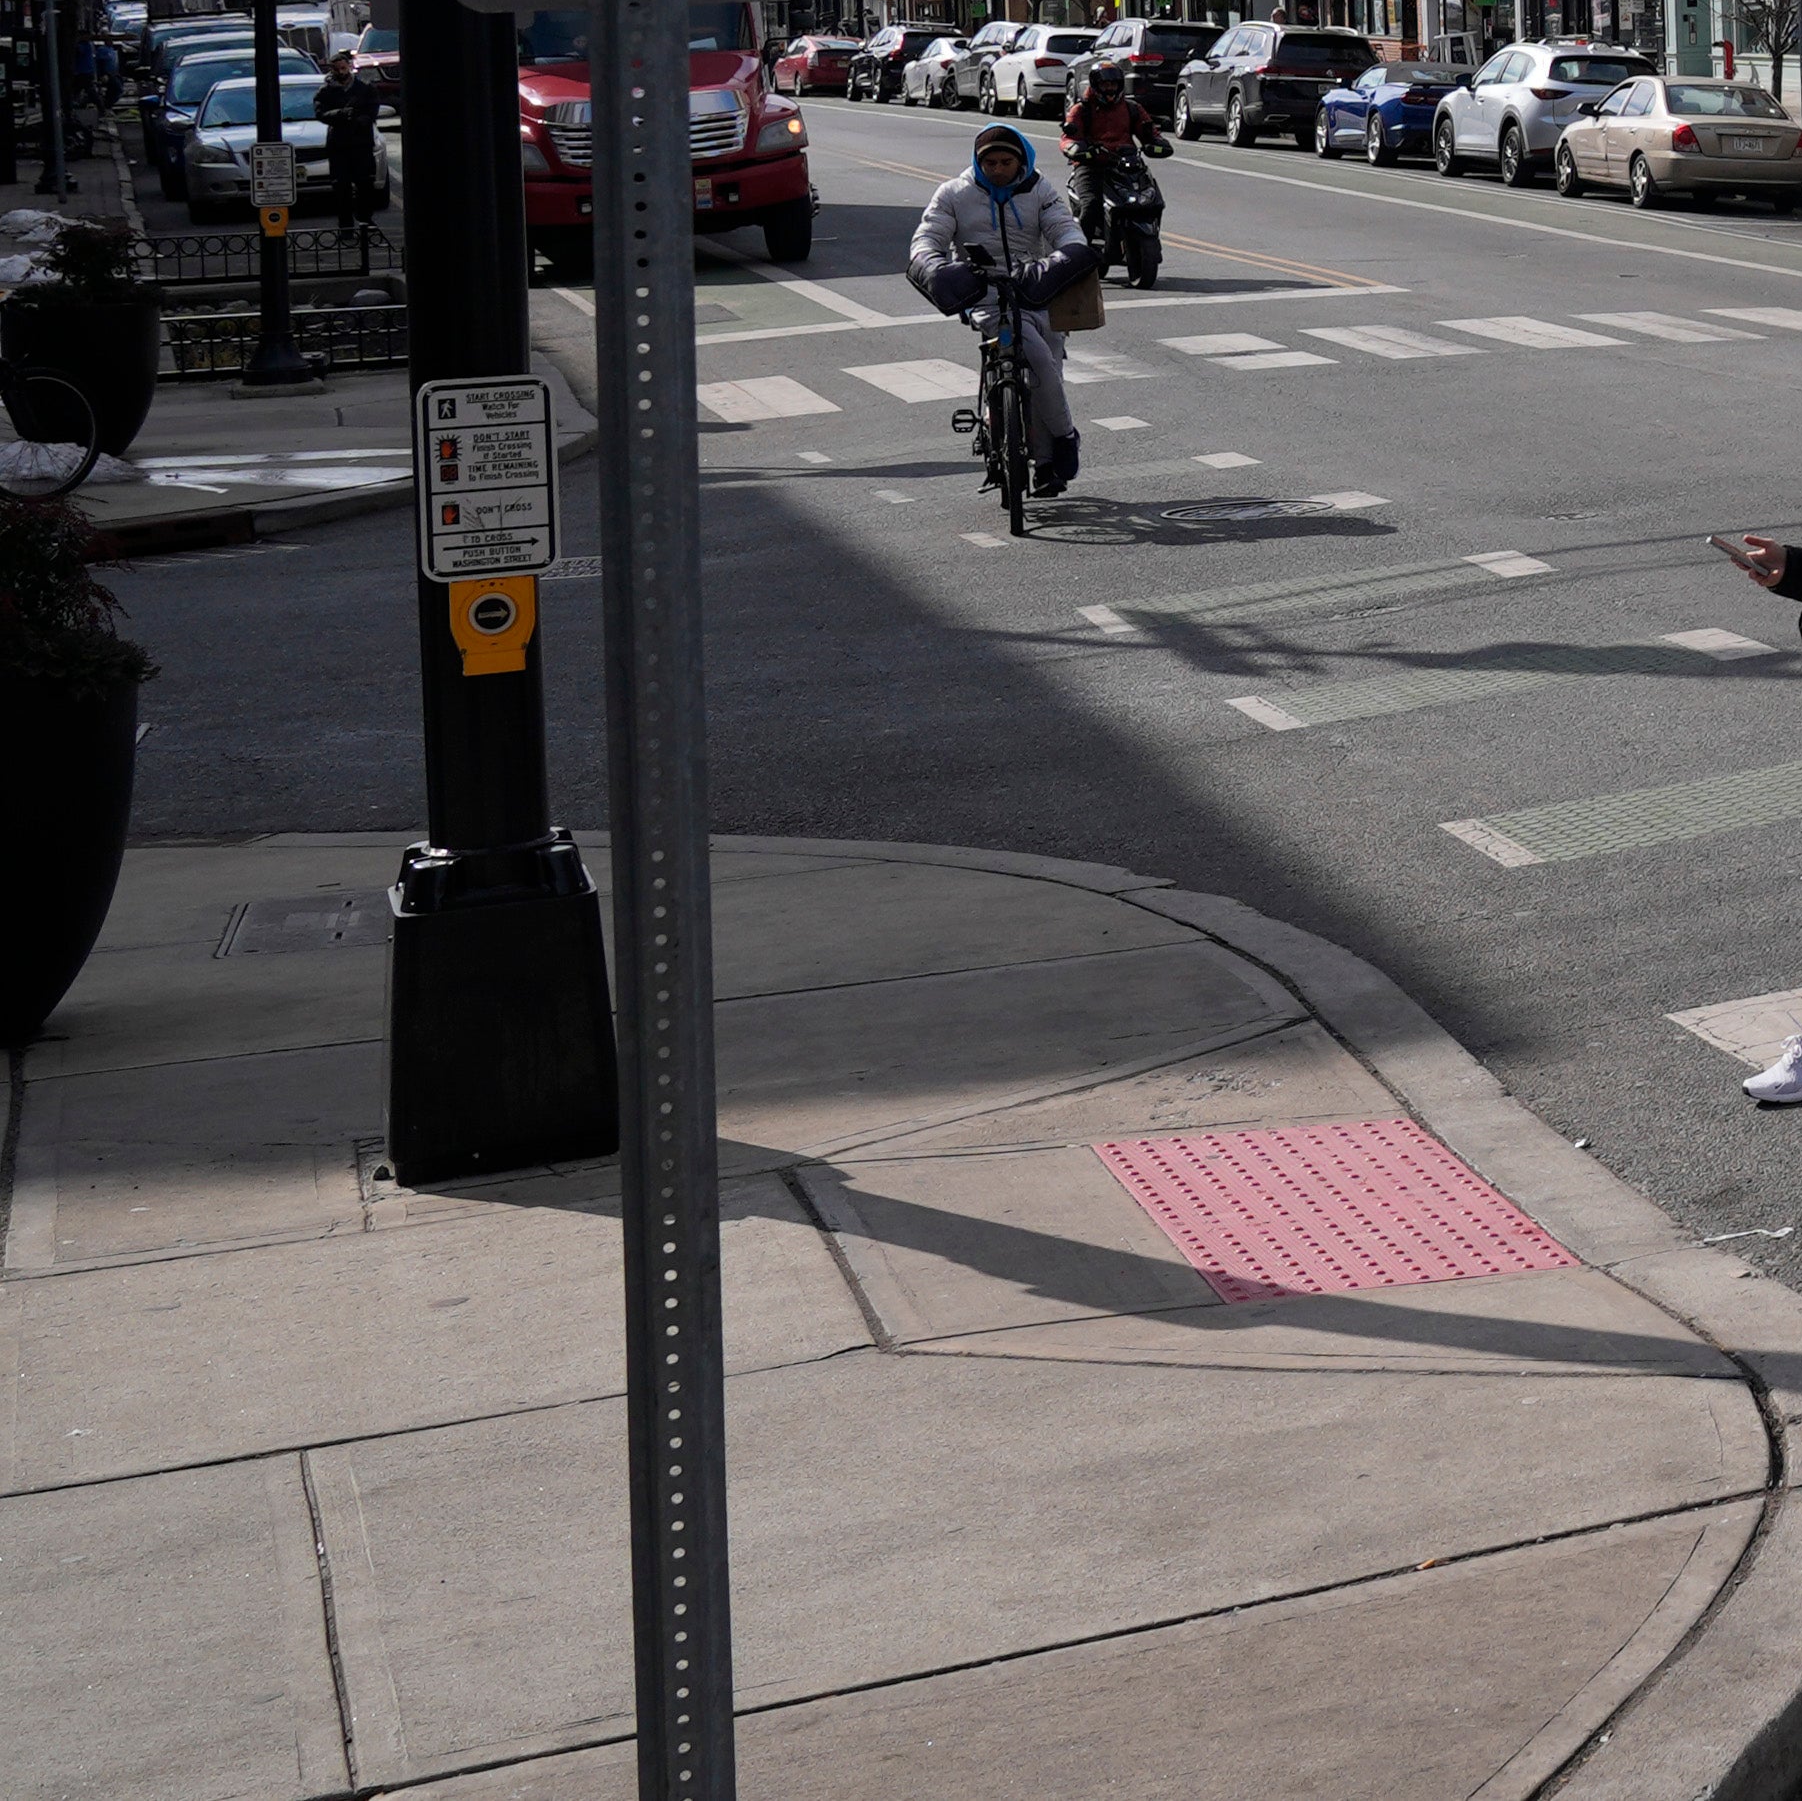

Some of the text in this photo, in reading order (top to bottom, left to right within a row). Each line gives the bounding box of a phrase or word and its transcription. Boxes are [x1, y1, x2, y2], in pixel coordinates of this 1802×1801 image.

[466, 390, 535, 402] START CROSSING
[485, 410, 518, 420] Vehicles
[473, 431, 530, 442] DON'T START
[473, 442, 533, 452] Finish Crossing
[493, 450, 522, 459] Started
[467, 461, 539, 473] TIME REMAINING
[479, 471, 503, 481] Finish
[505, 469, 540, 479] Crossing
[476, 502, 533, 514] DON'T CROSS
[484, 534, 514, 543] CROSS
[463, 546, 522, 558] PUSH BUTTON
[452, 554, 533, 569] WASHINGTON STREET
